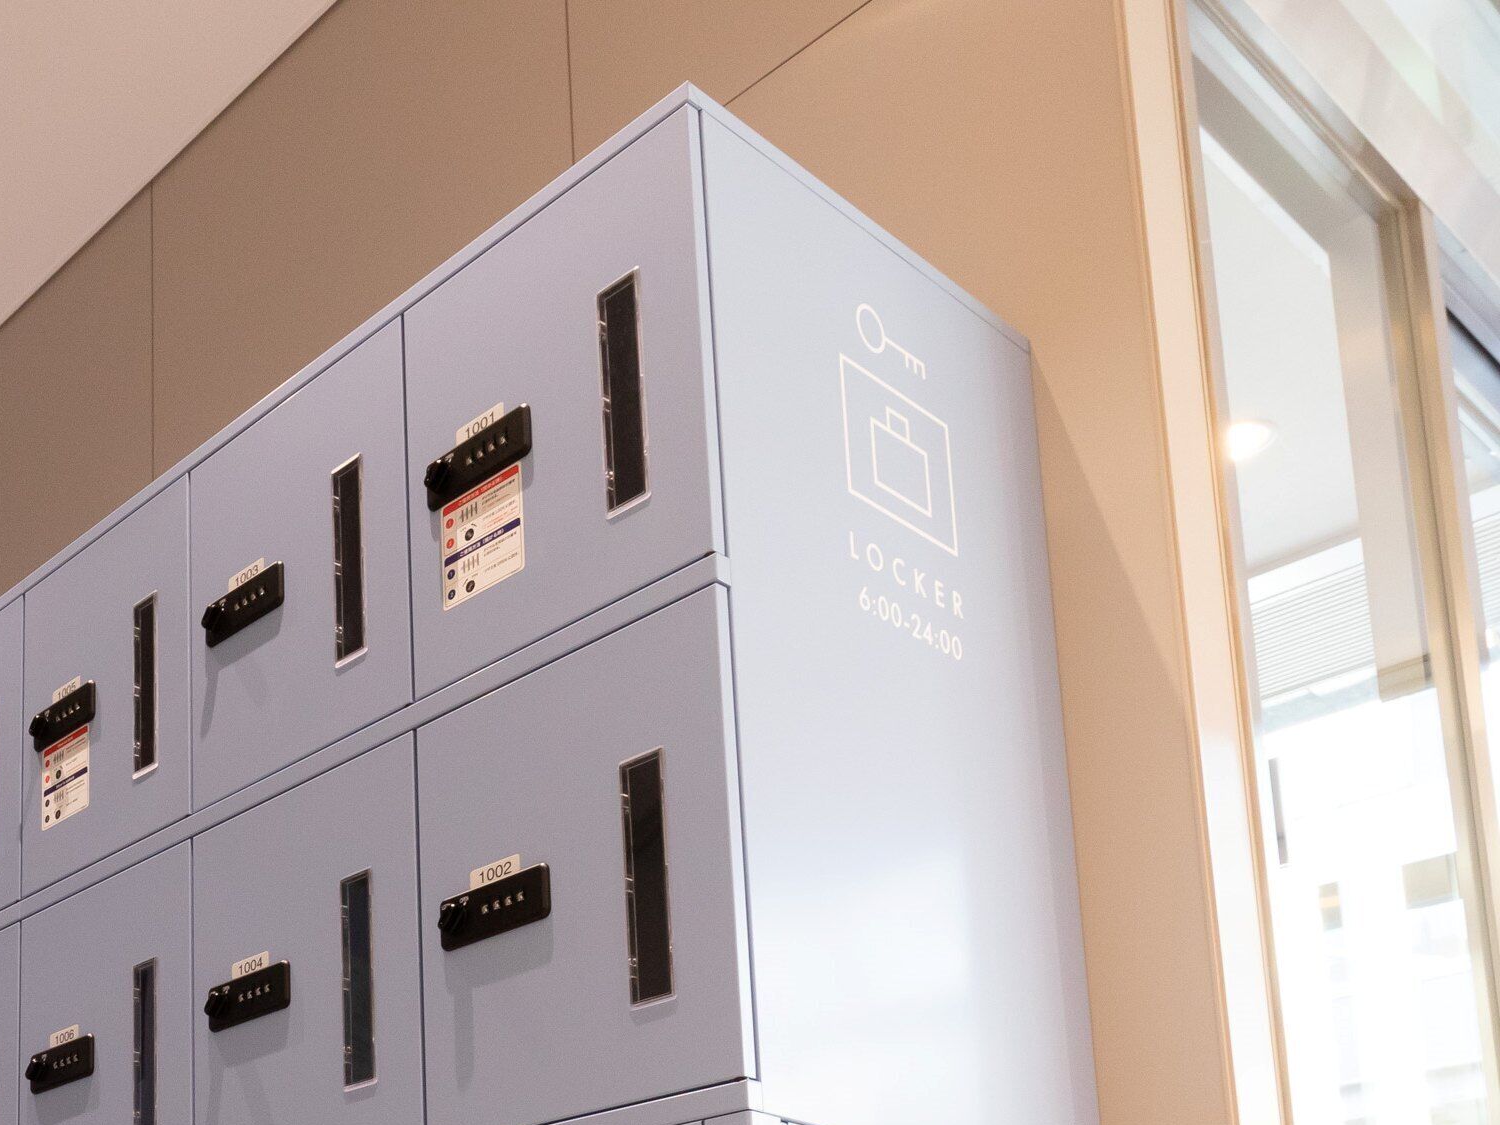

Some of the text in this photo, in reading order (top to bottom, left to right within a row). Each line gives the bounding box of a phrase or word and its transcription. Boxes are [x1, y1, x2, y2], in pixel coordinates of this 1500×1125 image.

[464, 411, 497, 438] 1001
[235, 564, 260, 587] 1003
[849, 530, 964, 619] LOCKER
[859, 586, 963, 661] 6:00-24:00
[479, 861, 513, 883] 1002
[238, 957, 263, 975] 1004
[55, 1029, 75, 1045] 1006
